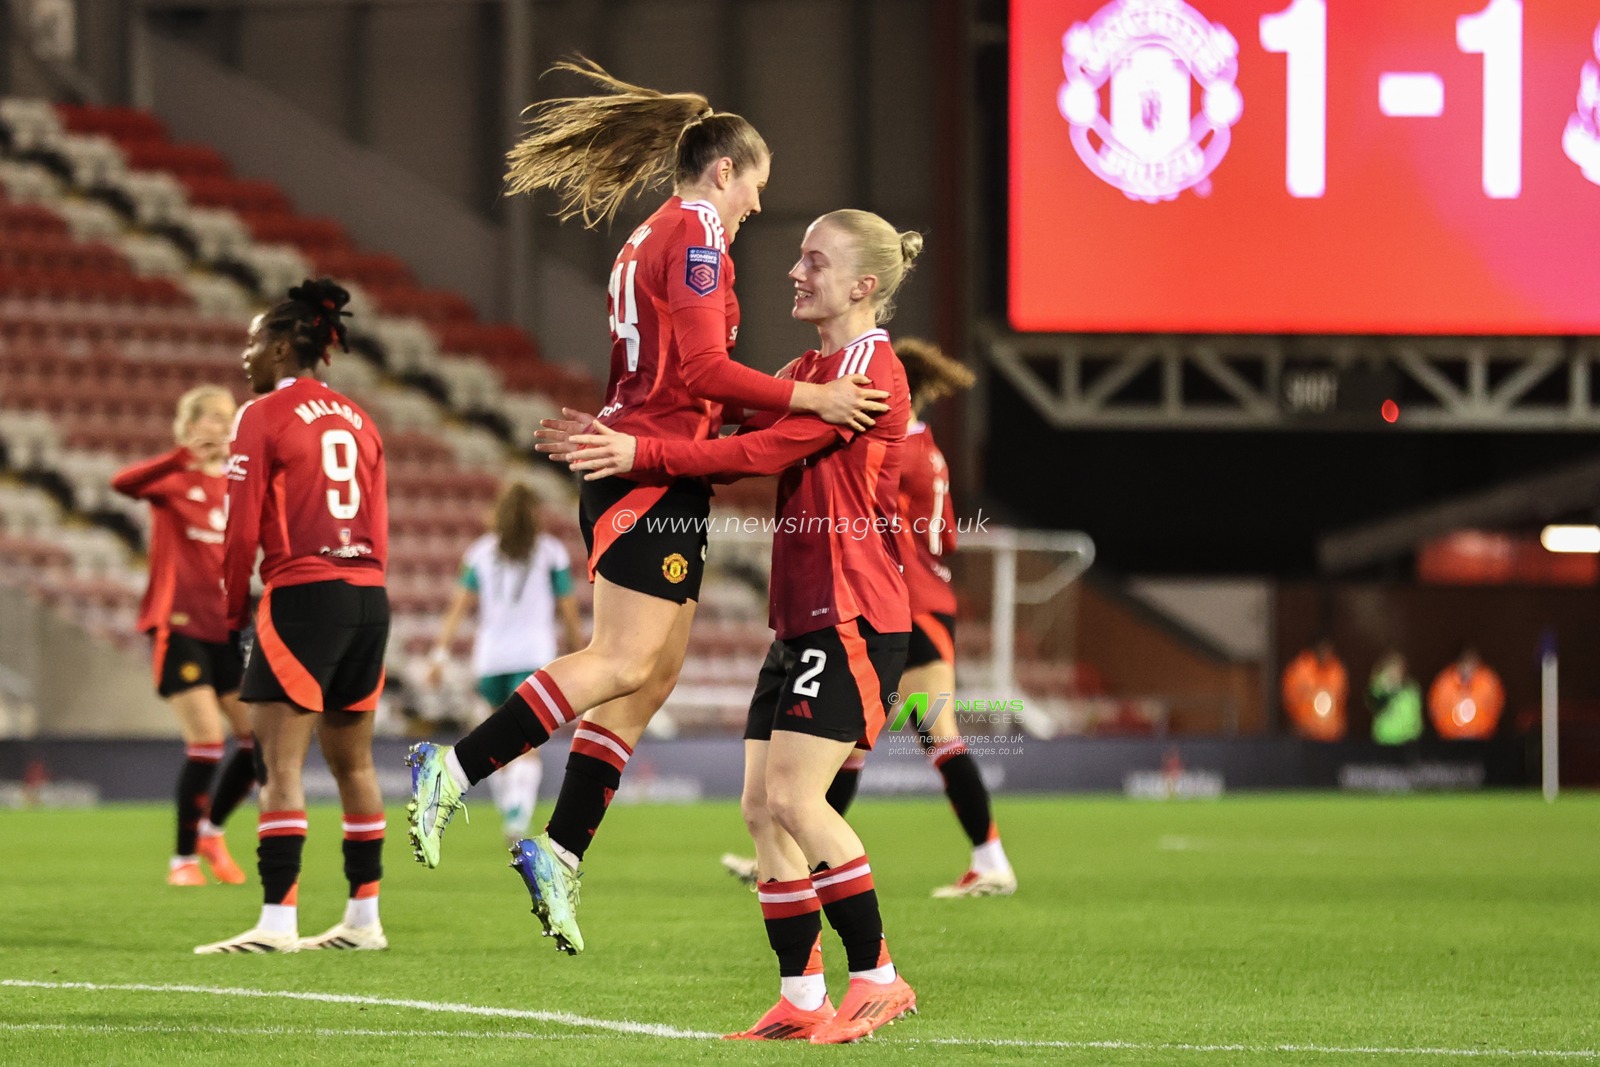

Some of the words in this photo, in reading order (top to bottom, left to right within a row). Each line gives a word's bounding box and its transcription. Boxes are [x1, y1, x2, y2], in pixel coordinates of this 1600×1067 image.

[1259, 0, 1327, 198] 1
[1455, 0, 1523, 199] 1
[321, 428, 361, 520] 9
[792, 648, 827, 698] 2
